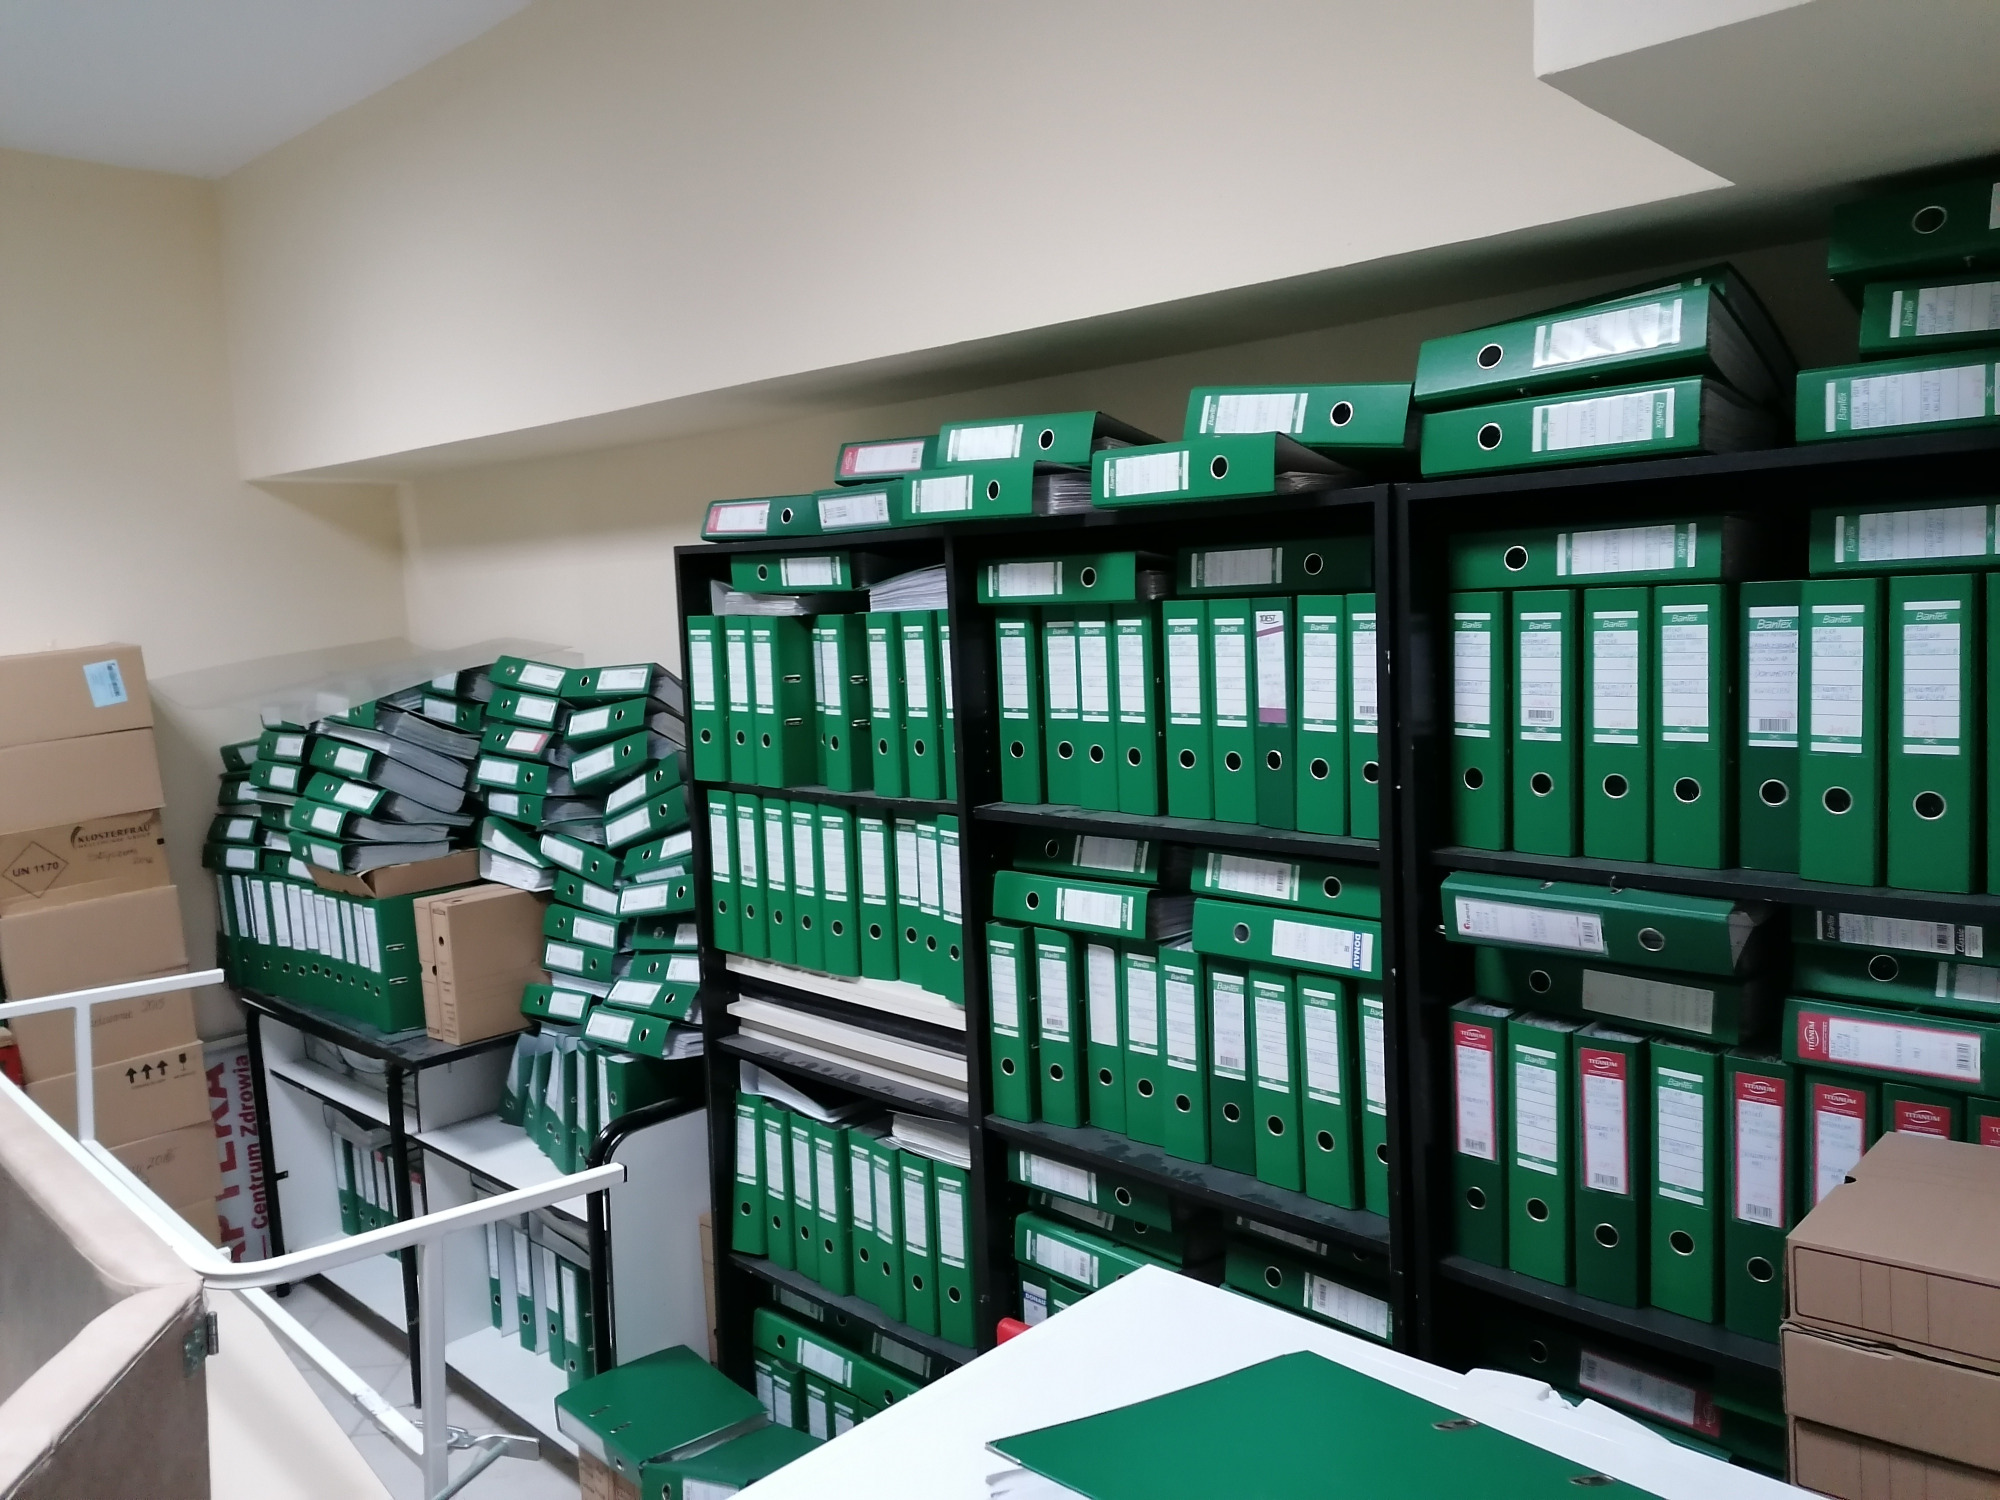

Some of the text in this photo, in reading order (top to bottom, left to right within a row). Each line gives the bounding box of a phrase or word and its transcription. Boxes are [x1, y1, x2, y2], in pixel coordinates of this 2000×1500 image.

[1837, 392, 1847, 421] Bantex
[1656, 402, 1665, 428] Bantex
[1671, 614, 1698, 623] Bantex
[1823, 614, 1852, 624] Bantex
[1916, 611, 1948, 621] Bantex
[1359, 622, 1376, 630] Bante
[1603, 620, 1628, 629] Bantex
[1757, 619, 1792, 629] Bantex
[77, 823, 151, 844] KLOSTERFRAU
[12, 861, 59, 877] UN 1170
[1353, 932, 1362, 969] DONAU
[1808, 1020, 1816, 1051] TITANUM
[1743, 1082, 1776, 1094] TITANUM
[1823, 1093, 1857, 1105] TITANUM
[1905, 1111, 1941, 1123] TITANUM
[233, 1054, 268, 1230] Centrum Zdrowia
